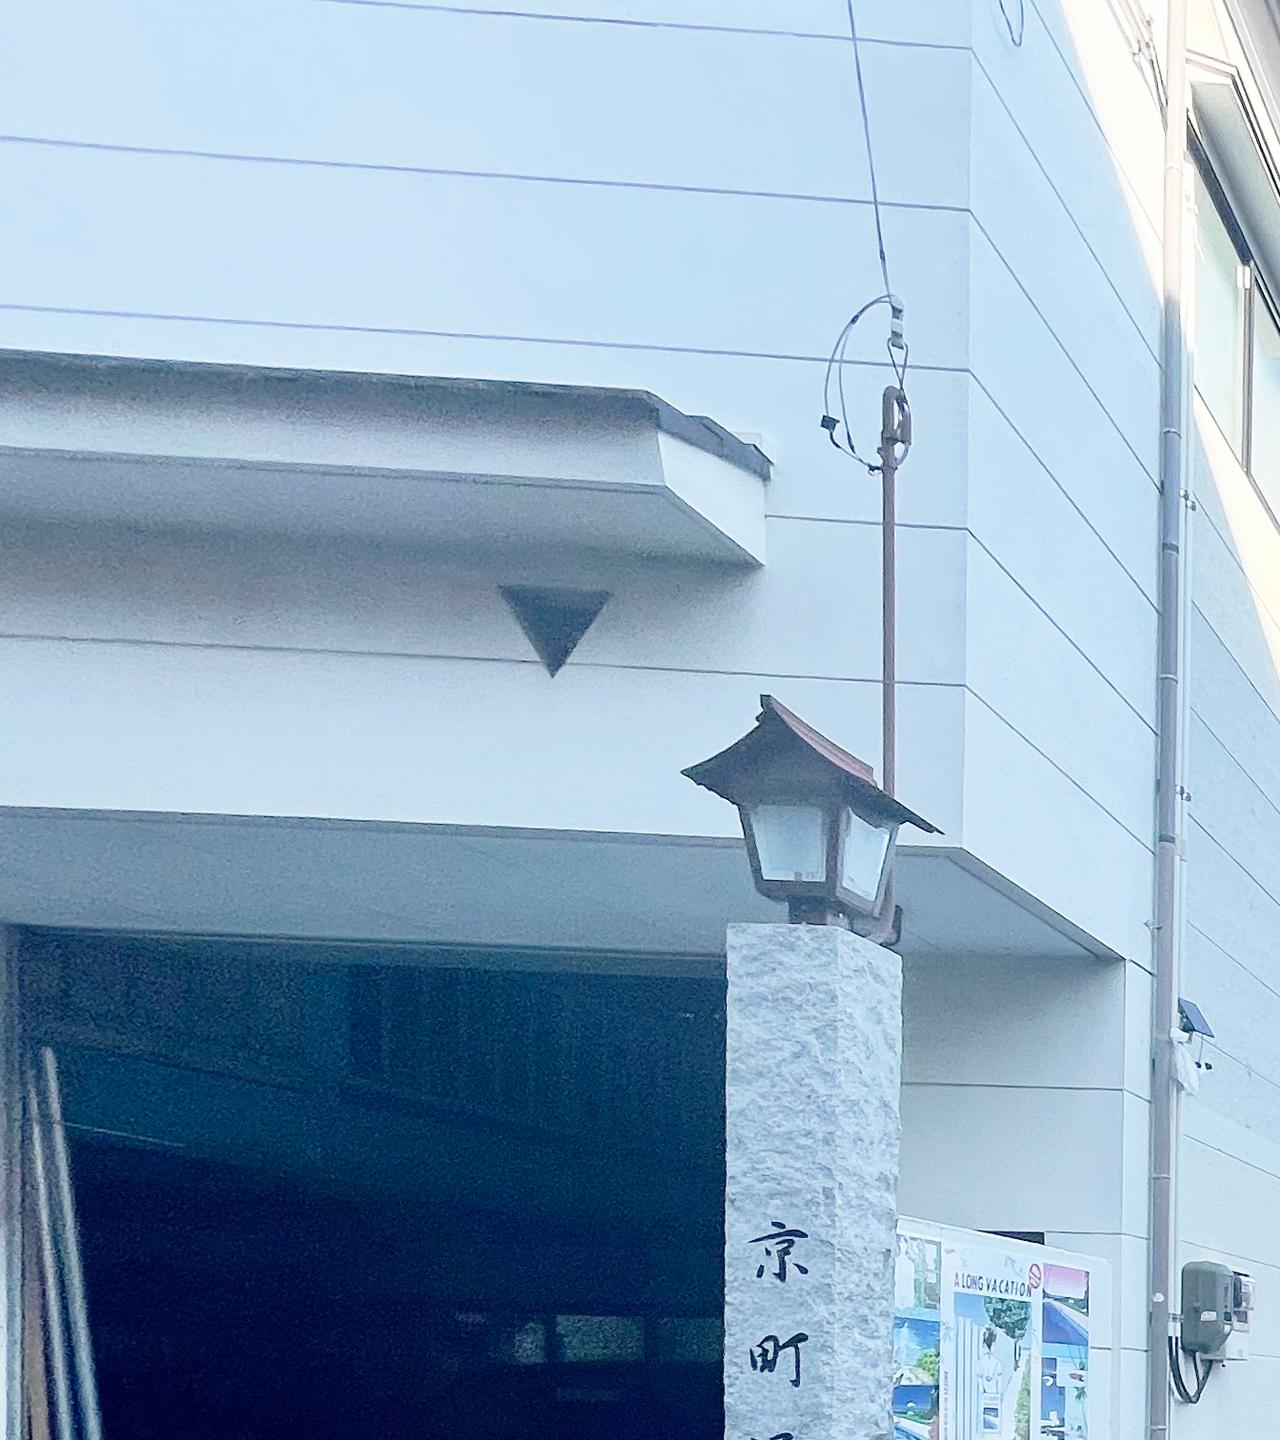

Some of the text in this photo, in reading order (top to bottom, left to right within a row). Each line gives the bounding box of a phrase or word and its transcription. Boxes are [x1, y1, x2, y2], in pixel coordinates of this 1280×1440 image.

[953, 1272, 1032, 1298] A LONG VACATION
